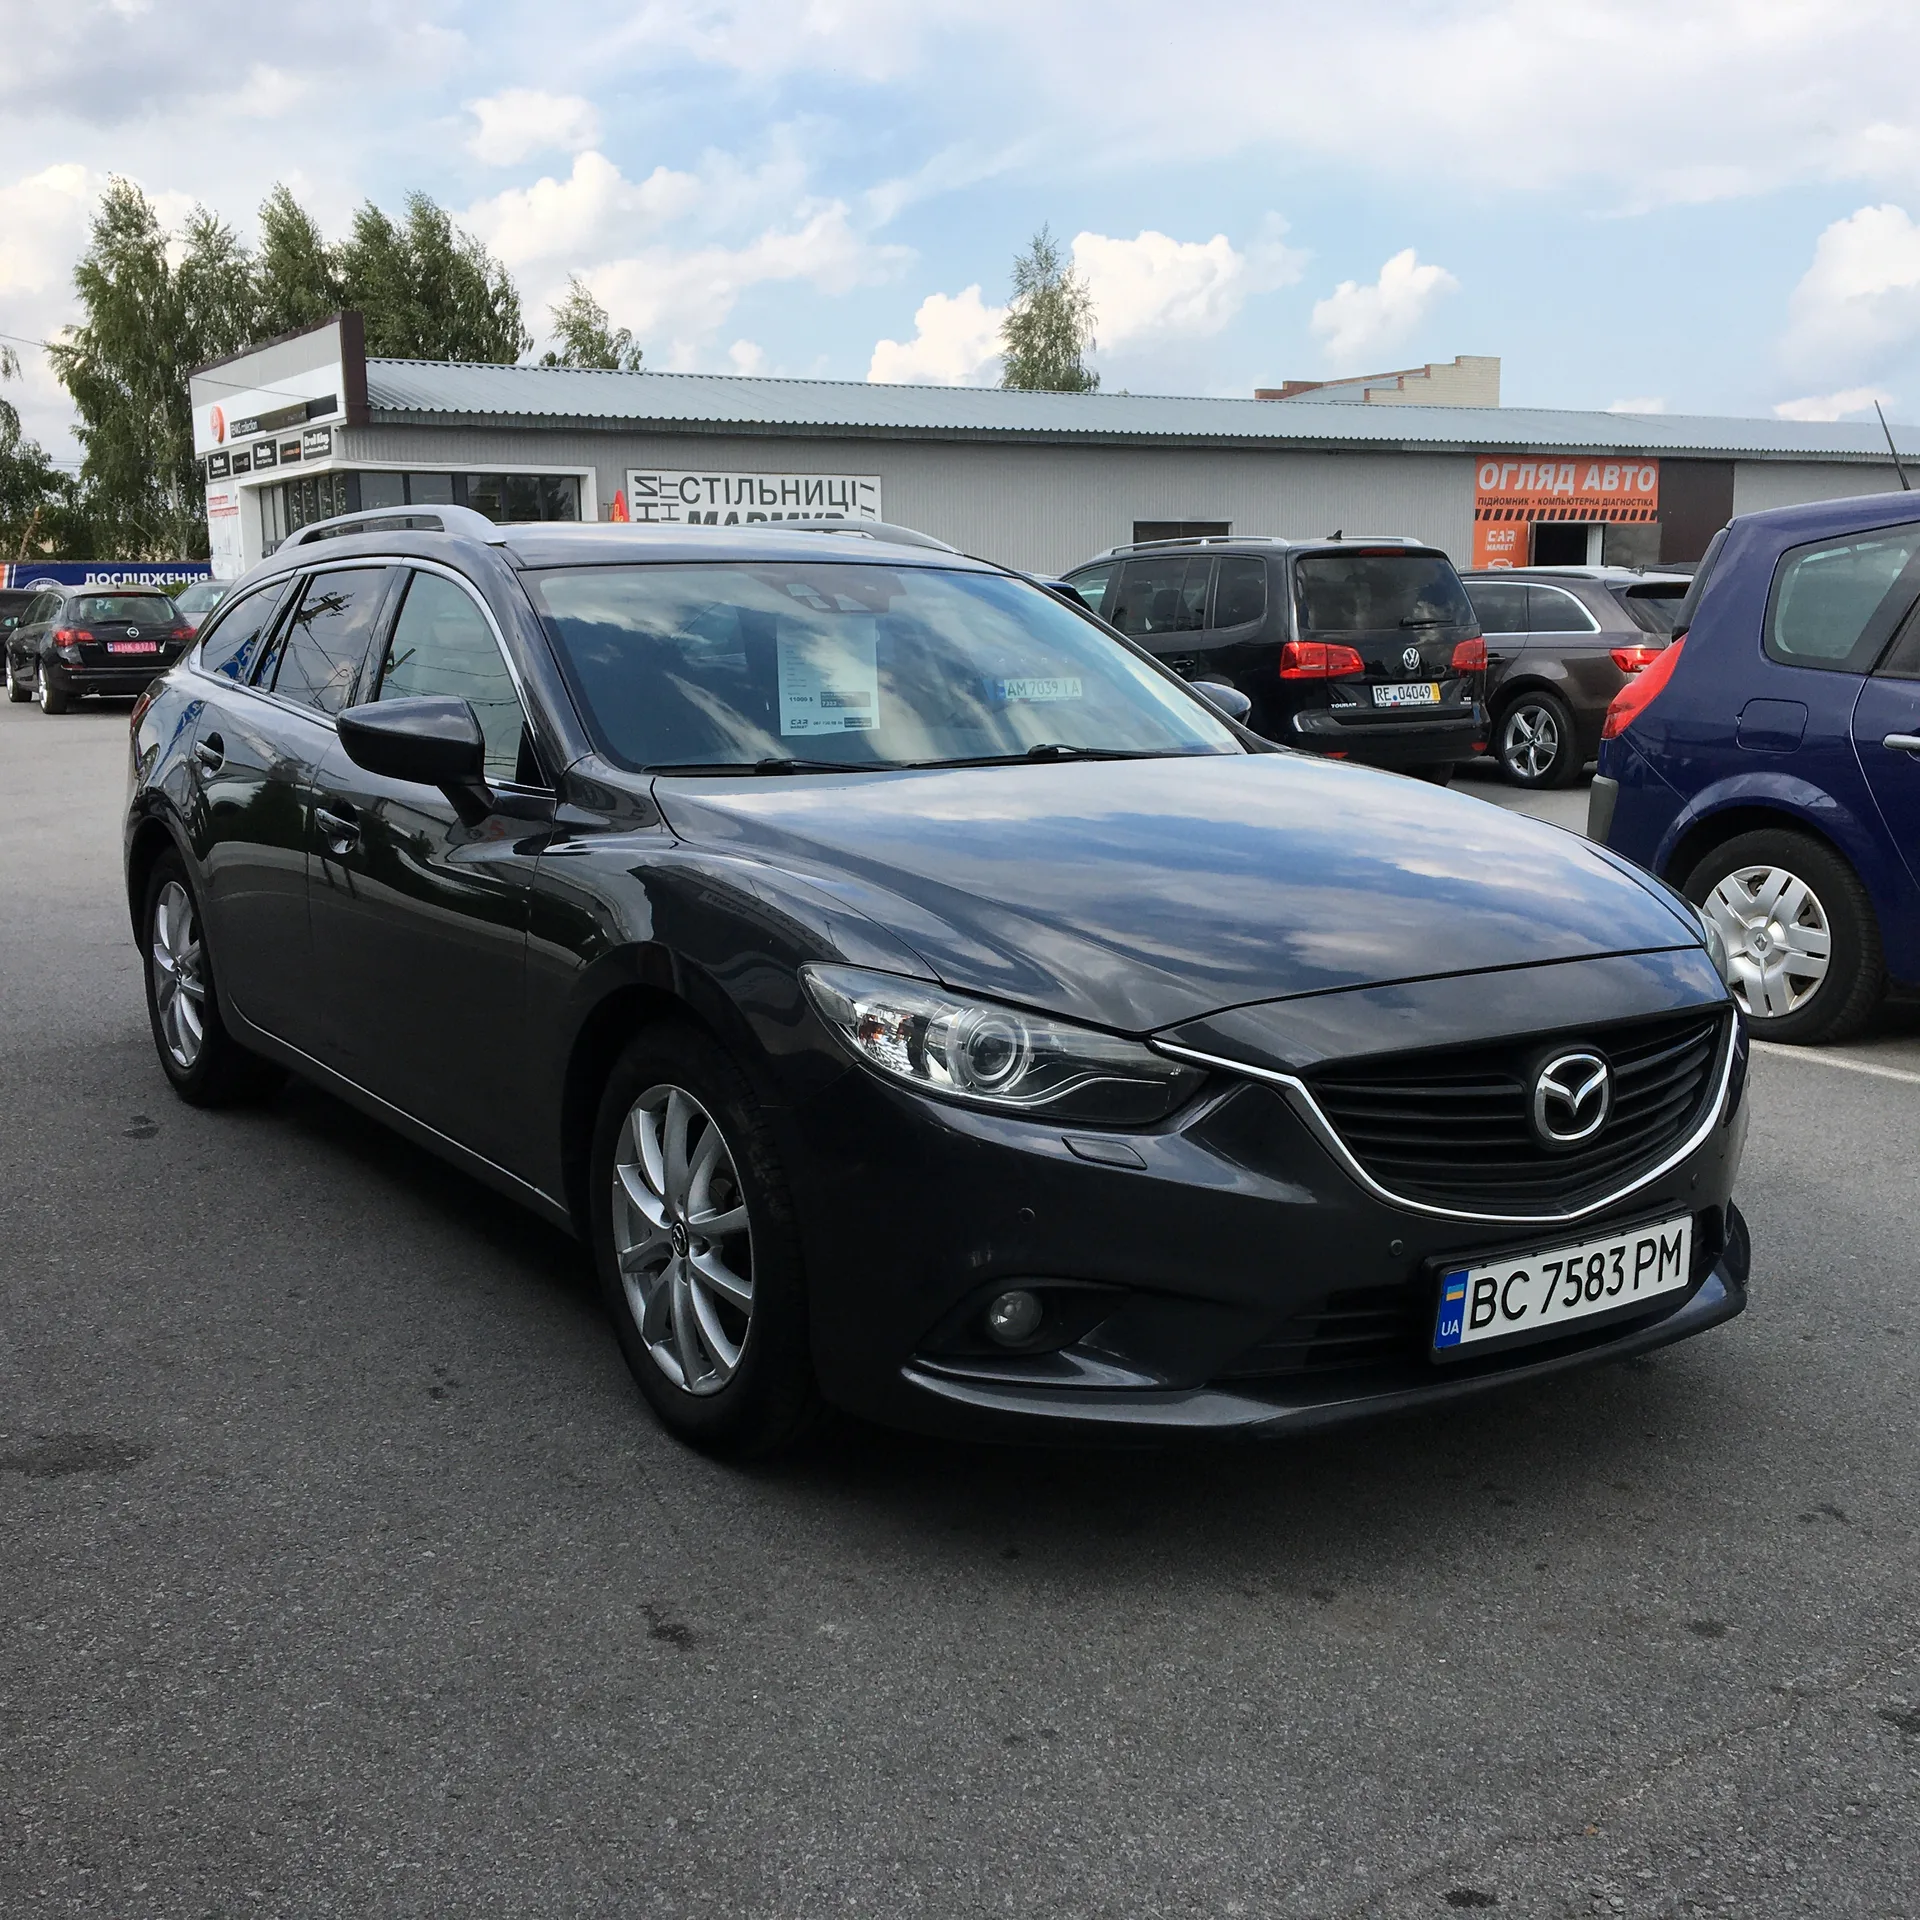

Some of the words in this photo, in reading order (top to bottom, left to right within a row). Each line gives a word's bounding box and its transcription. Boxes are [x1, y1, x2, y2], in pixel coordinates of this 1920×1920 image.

[1479, 462, 1575, 495] ОГЛЯД
[1582, 465, 1656, 492] АВТО
[679, 476, 857, 512] СТІЛЬНИЦІ
[1478, 496, 1529, 506] ПІДЙОМНИК
[1602, 498, 1654, 507] ДІАГНОСТІКА
[1487, 530, 1515, 542] CAR
[1486, 543, 1514, 551] MARKET
[84, 572, 208, 586] ДОСЛІДЖЕННЯ
[1007, 682, 1027, 696] AM
[1029, 681, 1058, 695] 7039
[1375, 687, 1392, 701] RE
[1399, 686, 1431, 700] 04049
[1441, 1322, 1459, 1336] UA
[1469, 1271, 1530, 1330] BC
[1541, 1246, 1625, 1314] 7583
[1633, 1229, 1683, 1290] PM
